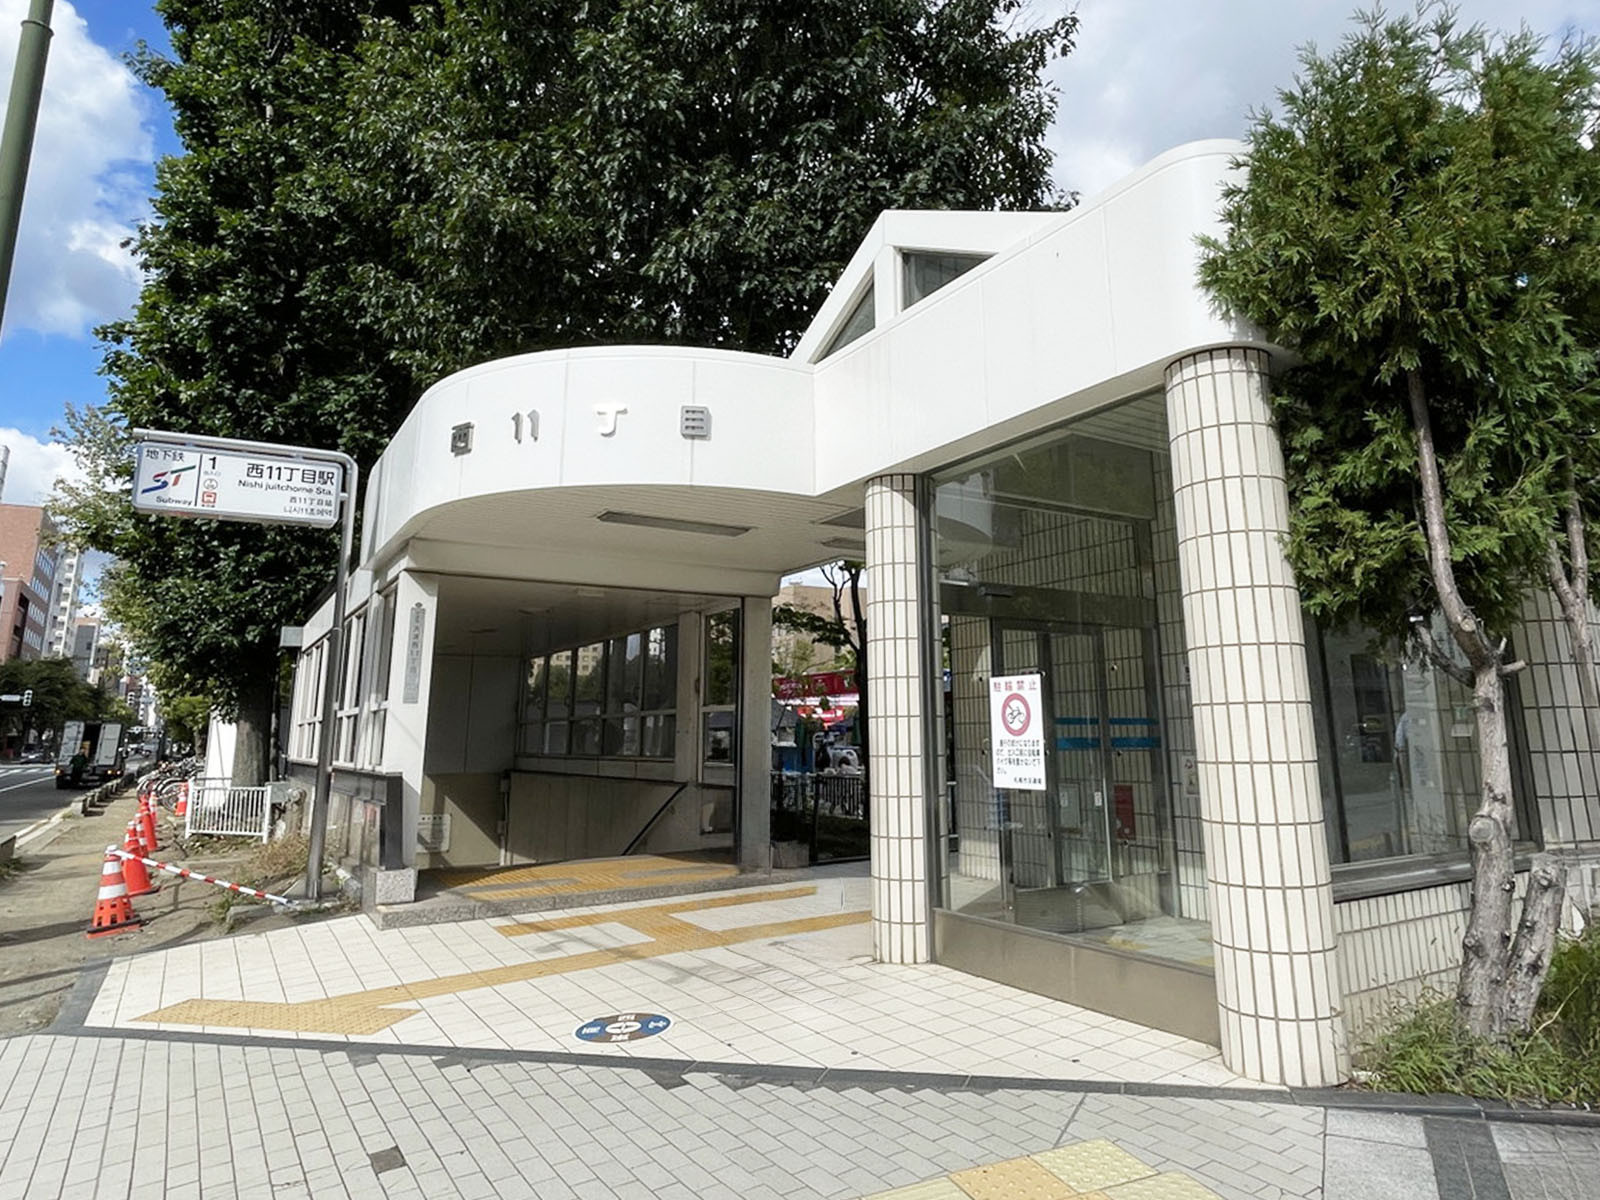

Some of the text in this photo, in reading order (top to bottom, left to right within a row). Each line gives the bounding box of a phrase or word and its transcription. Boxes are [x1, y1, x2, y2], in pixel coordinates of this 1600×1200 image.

[145, 448, 185, 462] 地下鉄
[208, 456, 217, 470] 1
[246, 463, 335, 486] 西11丁目駅
[238, 479, 264, 489] Nishi
[315, 487, 334, 496] Sta.
[155, 496, 193, 506] Subway
